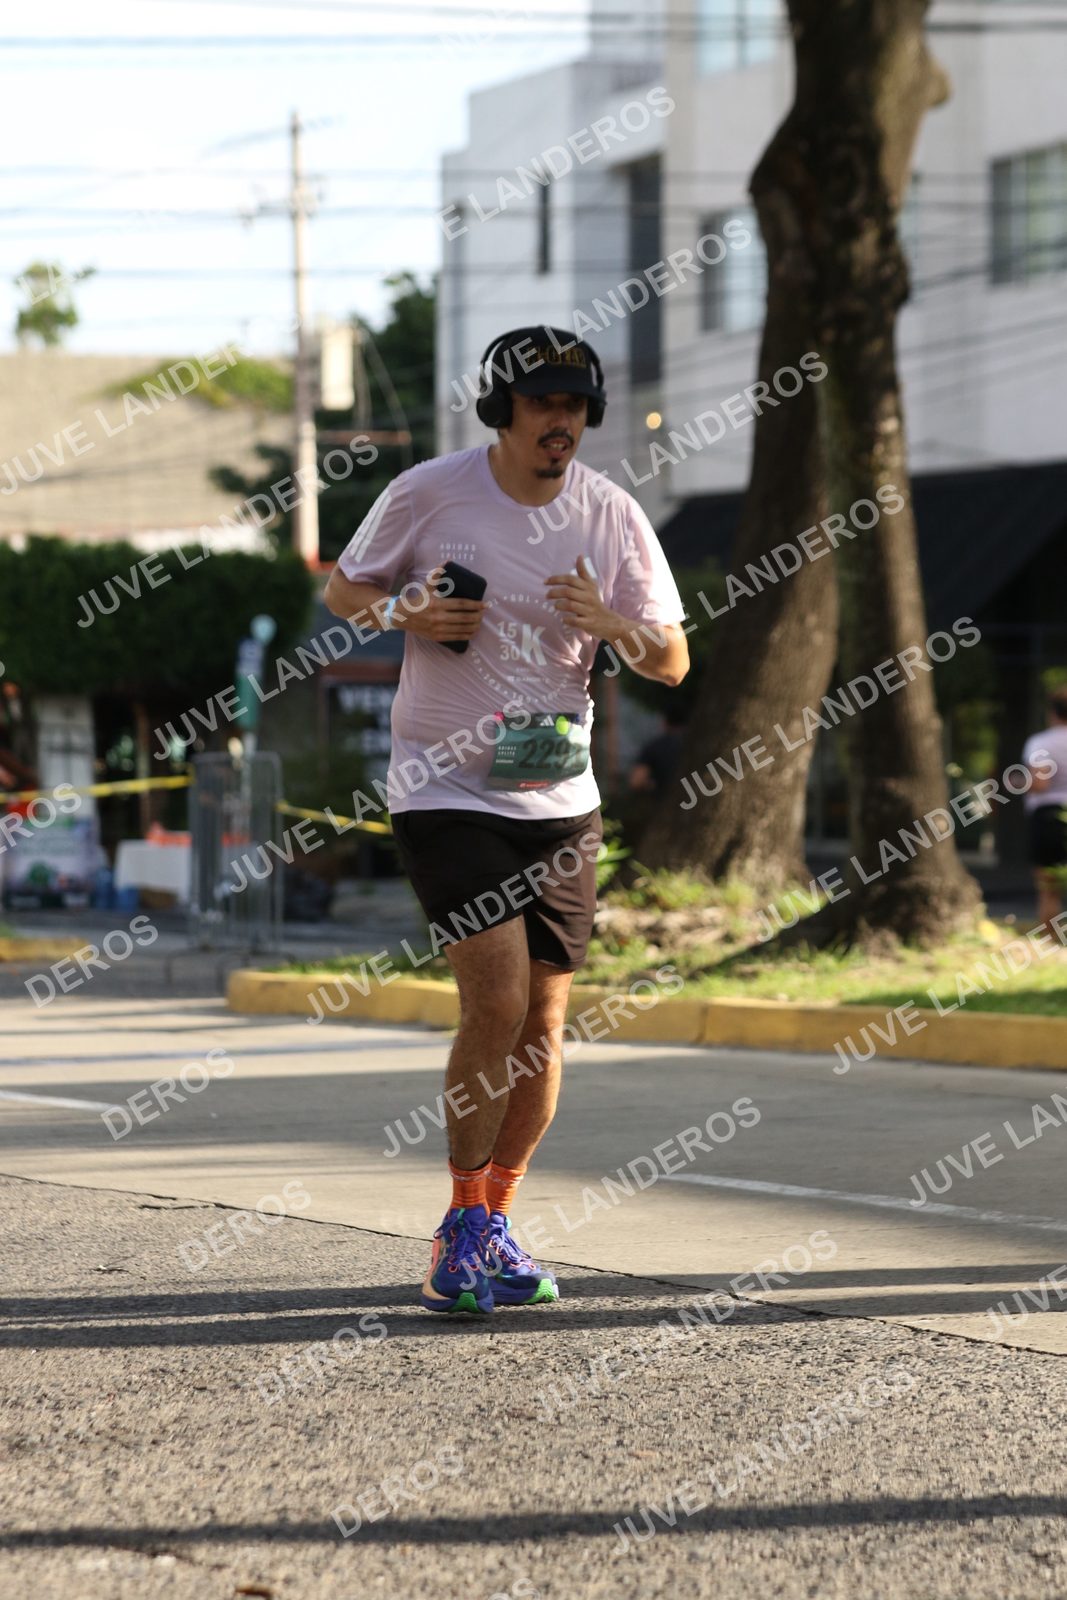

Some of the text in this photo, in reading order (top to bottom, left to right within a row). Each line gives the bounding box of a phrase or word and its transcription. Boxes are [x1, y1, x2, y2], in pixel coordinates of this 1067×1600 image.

[496, 621, 517, 639] 15
[499, 644, 521, 661] 30
[521, 624, 548, 666] K
